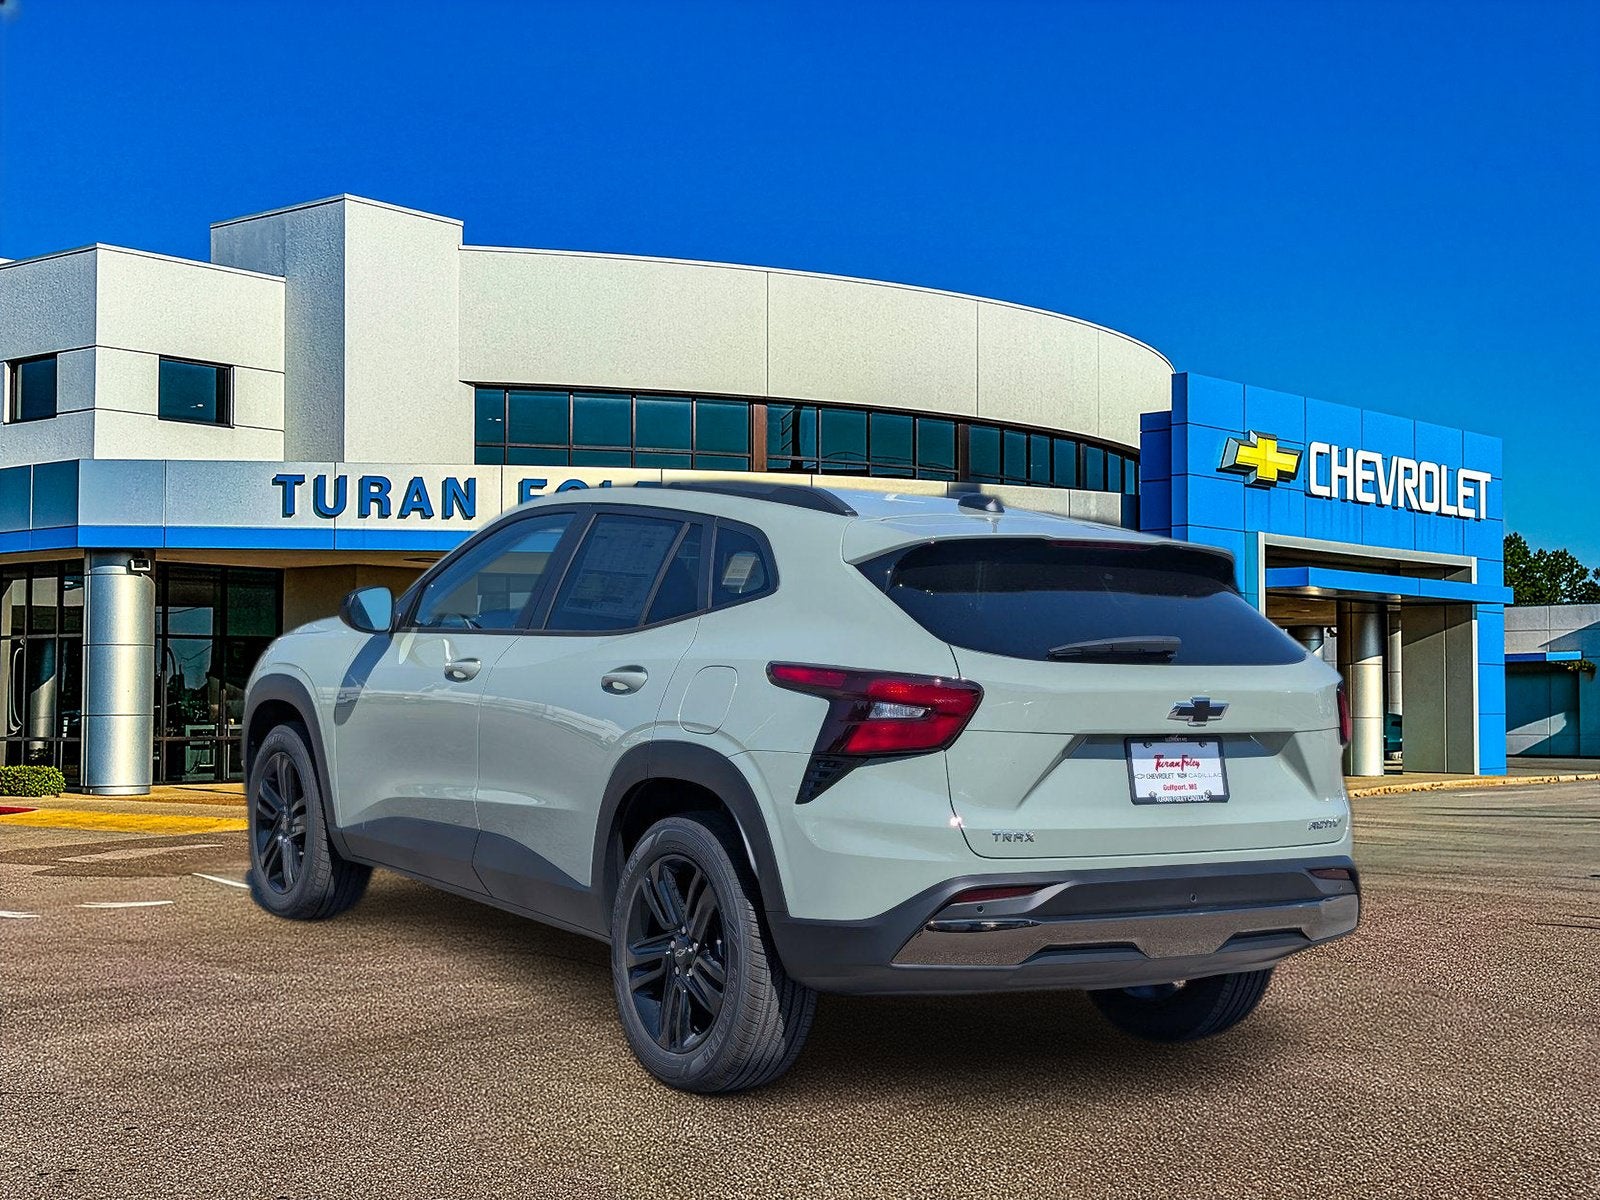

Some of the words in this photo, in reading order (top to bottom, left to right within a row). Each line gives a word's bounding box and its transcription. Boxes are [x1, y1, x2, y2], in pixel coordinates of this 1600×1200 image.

[1307, 441, 1492, 520] CHEVROLET
[272, 473, 477, 520] TURAN
[1145, 772, 1175, 780] CHEVROLET
[992, 829, 1035, 843] TRAX
